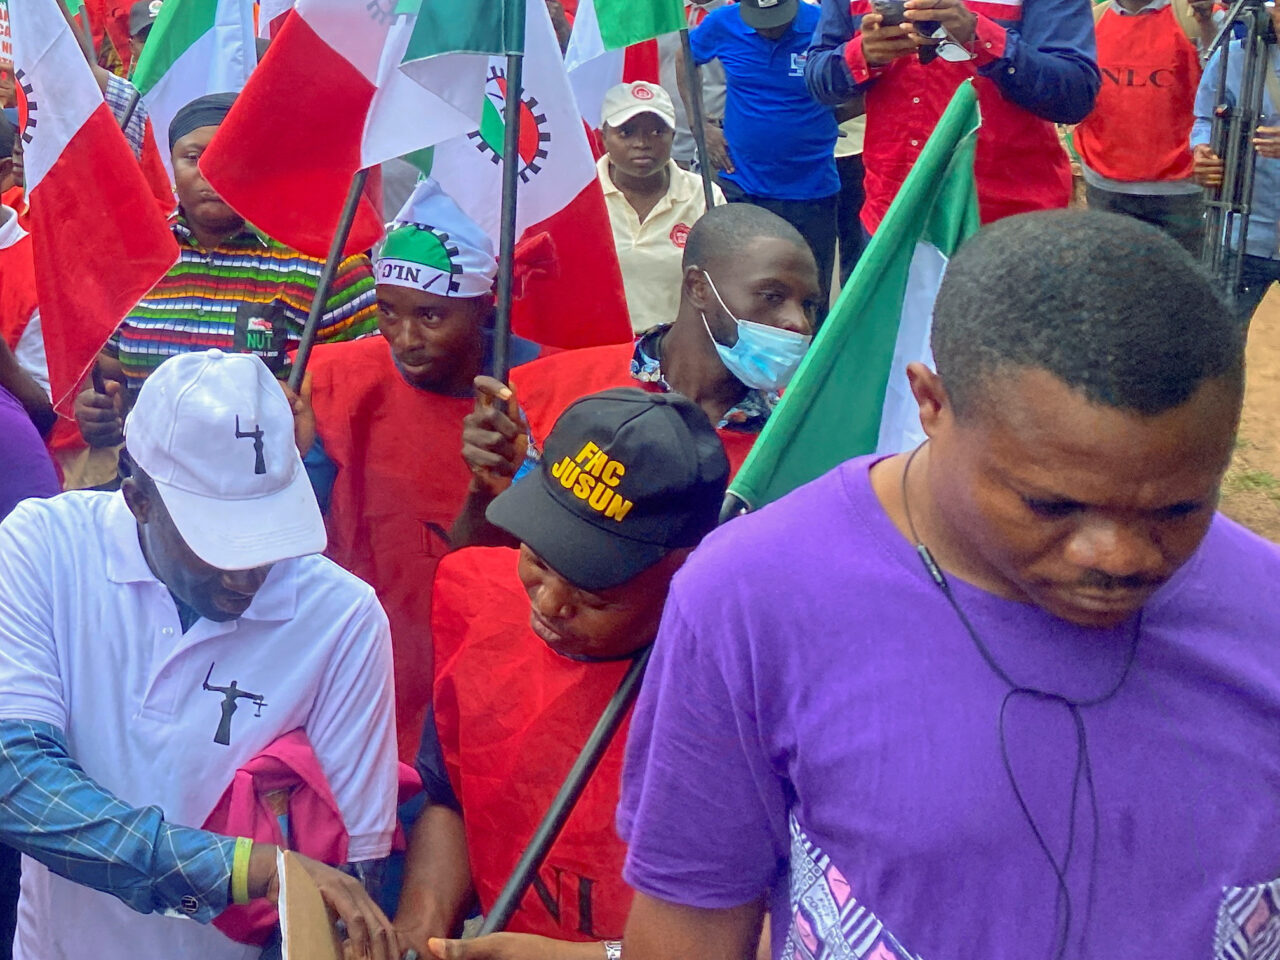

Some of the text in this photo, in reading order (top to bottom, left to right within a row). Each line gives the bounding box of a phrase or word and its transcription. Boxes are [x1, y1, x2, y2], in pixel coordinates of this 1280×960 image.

[248, 333, 272, 350] NUT
[575, 441, 625, 487] FHC
[552, 456, 633, 522] JUSUN
